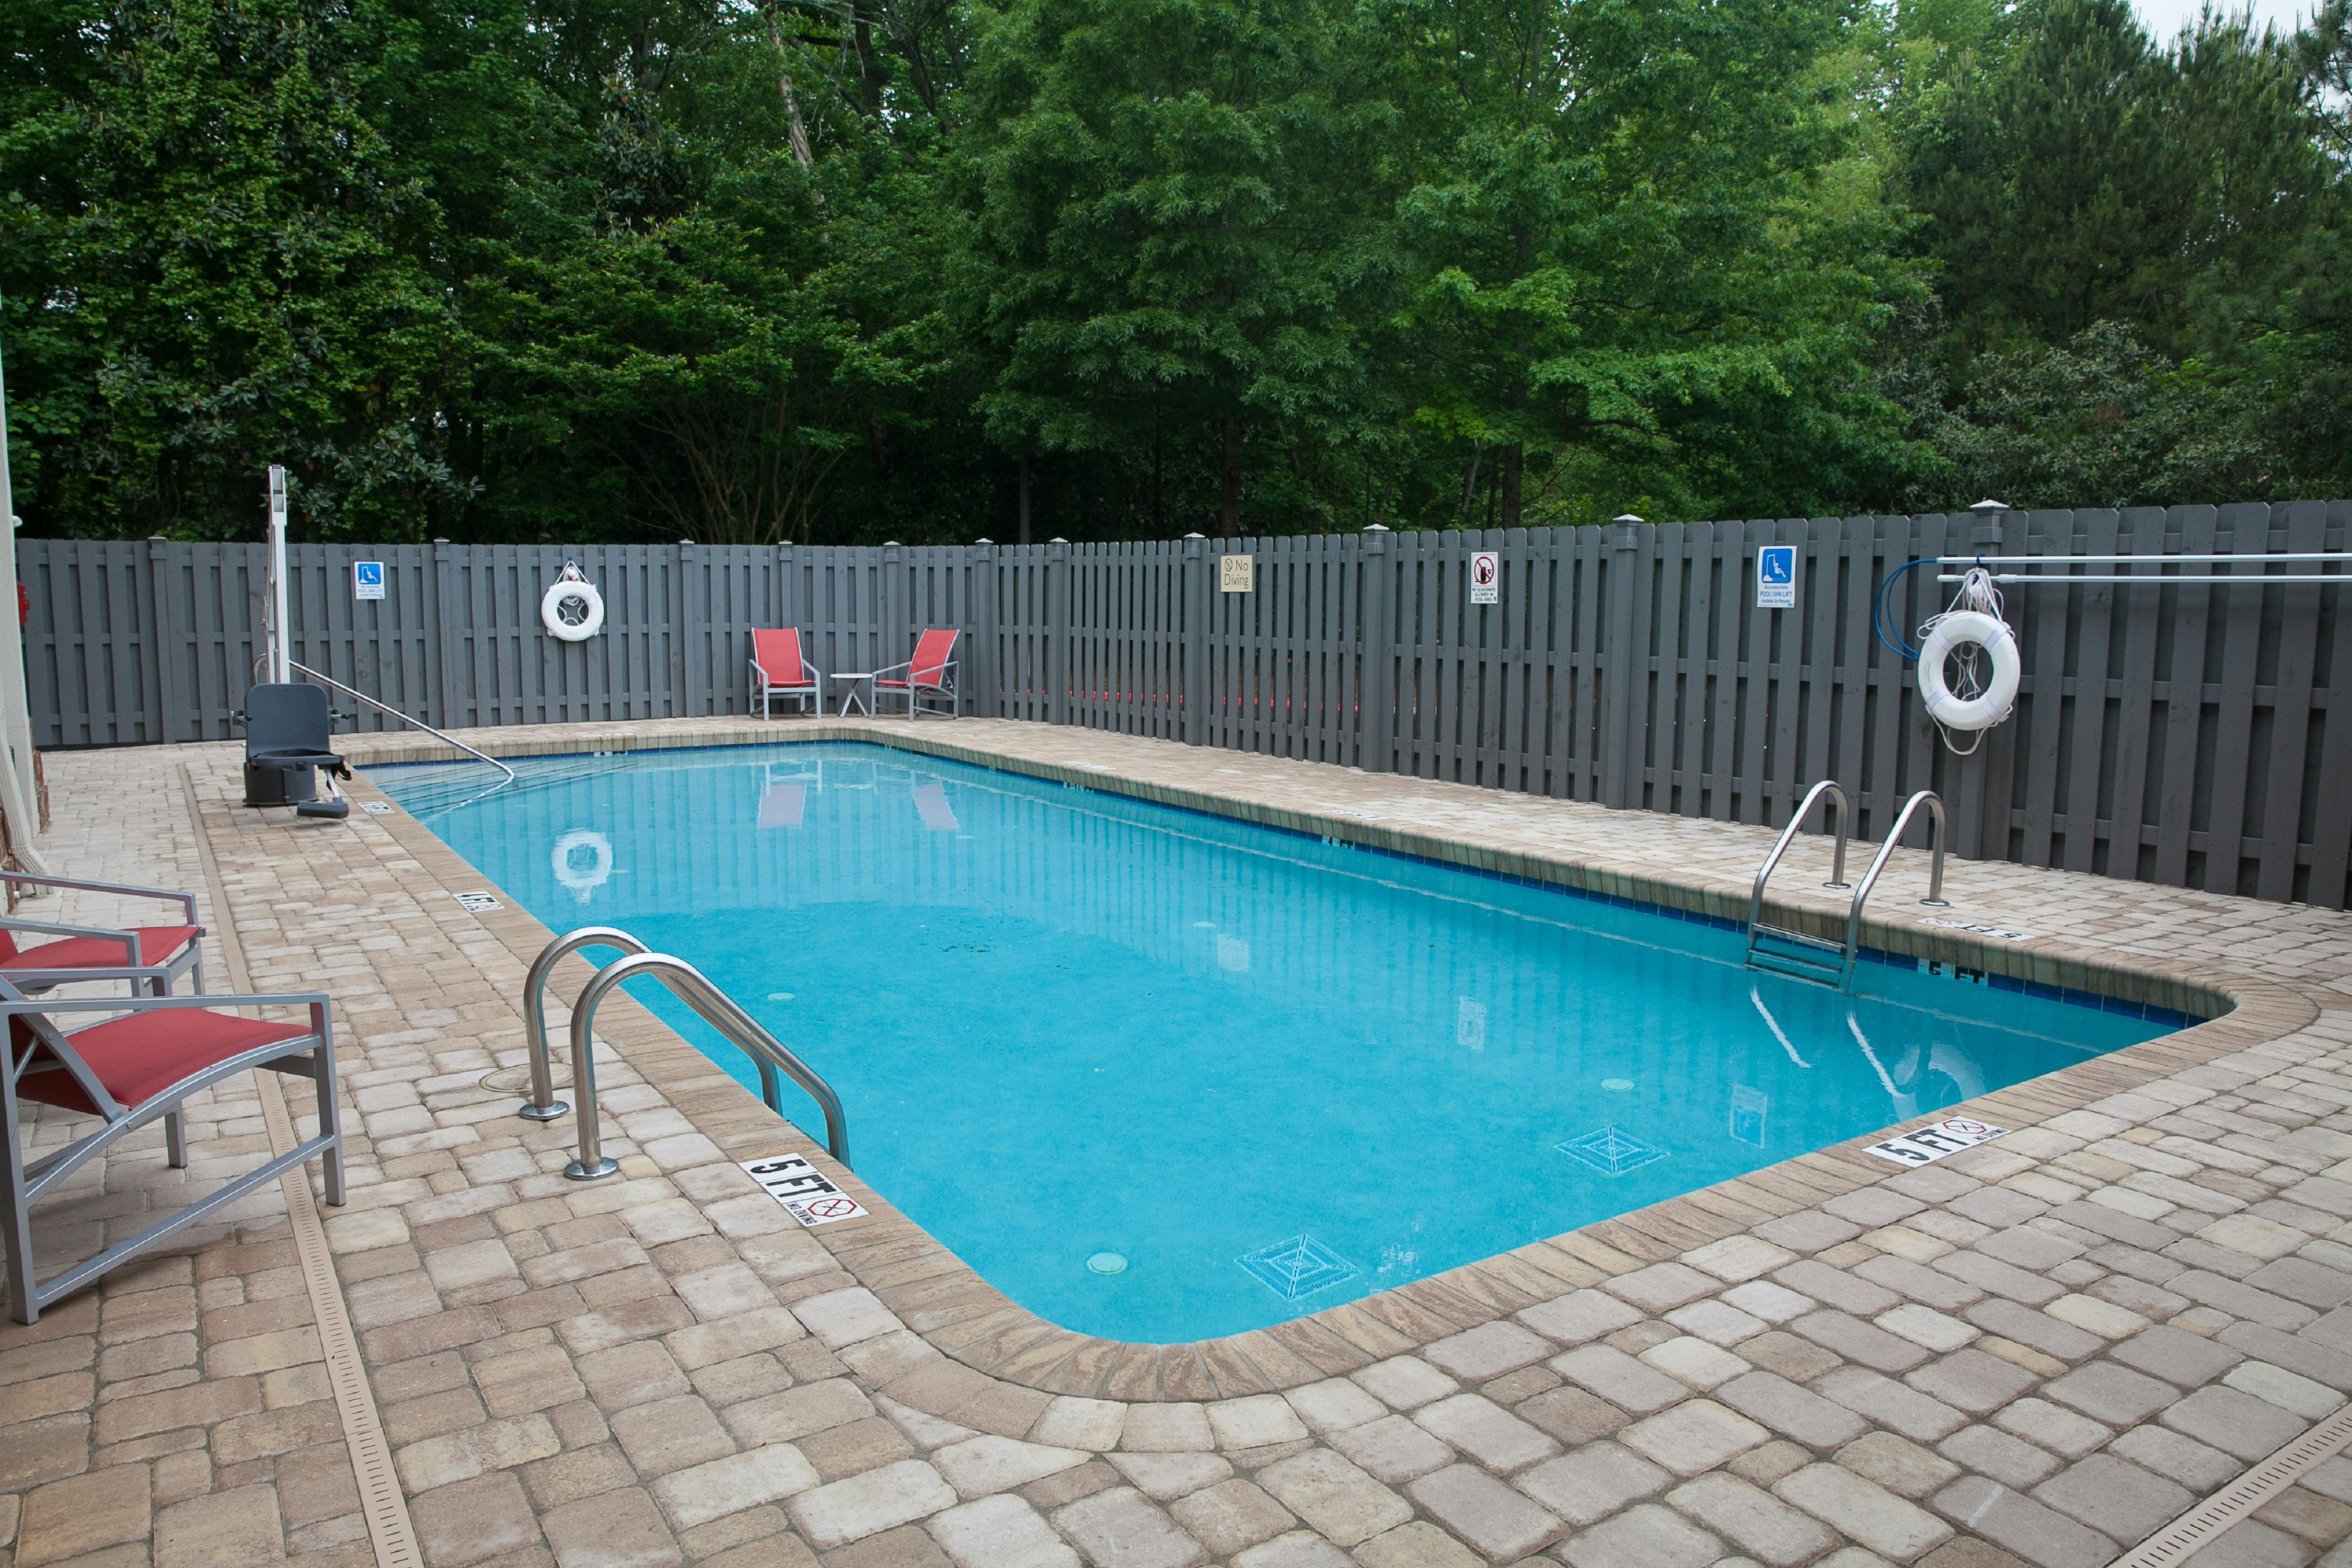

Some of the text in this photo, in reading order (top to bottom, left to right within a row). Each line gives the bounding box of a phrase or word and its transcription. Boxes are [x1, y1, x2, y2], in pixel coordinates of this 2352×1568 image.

[1236, 559, 1249, 571] No
[1225, 573, 1249, 589] Diving
[1928, 960, 1985, 984] 5 FT
[1875, 1128, 1970, 1161] 5 FT
[750, 1159, 837, 1197] 5 FT
[794, 1209, 817, 1224] DIVING
